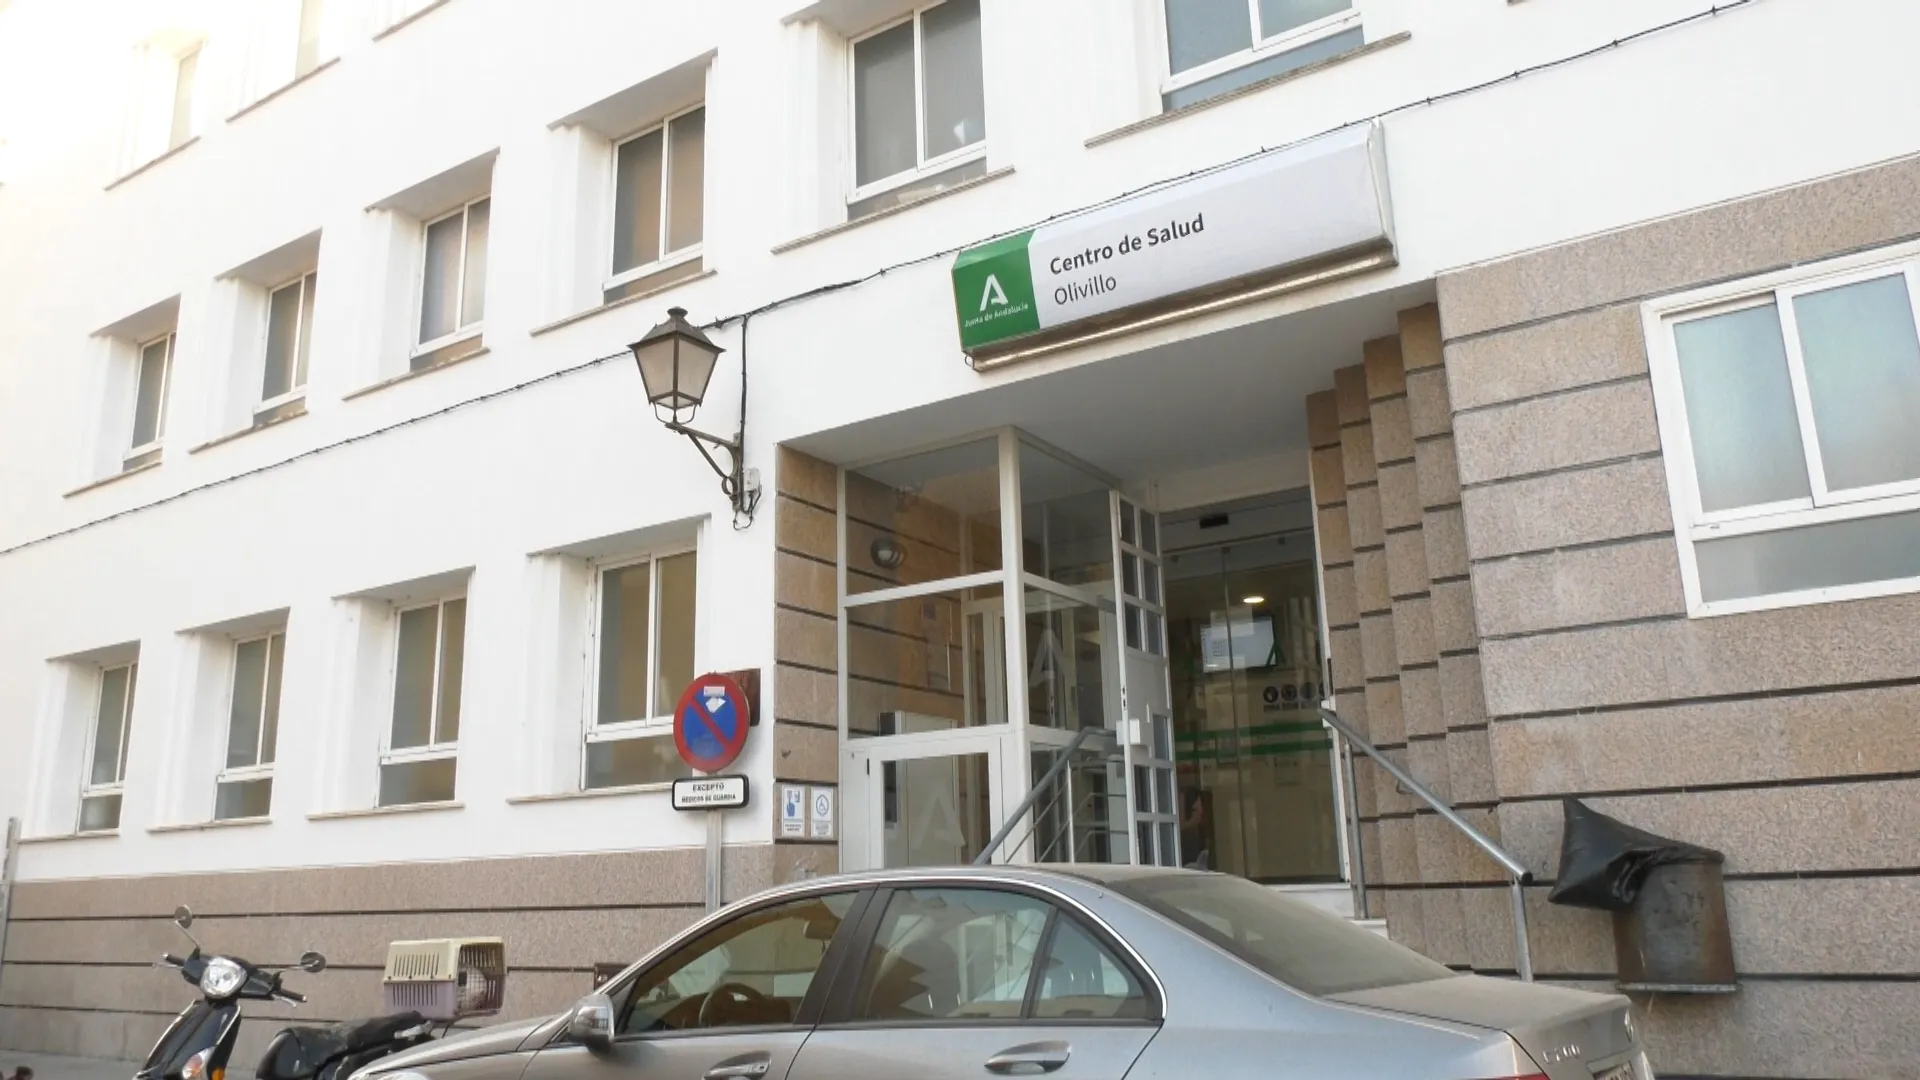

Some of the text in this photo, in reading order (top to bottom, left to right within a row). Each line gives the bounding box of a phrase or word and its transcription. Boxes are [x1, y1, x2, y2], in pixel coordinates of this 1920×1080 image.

[1049, 212, 1205, 275] Centro de Salud
[1053, 273, 1117, 306] Olivillo
[692, 782, 725, 793] EXCEPTO
